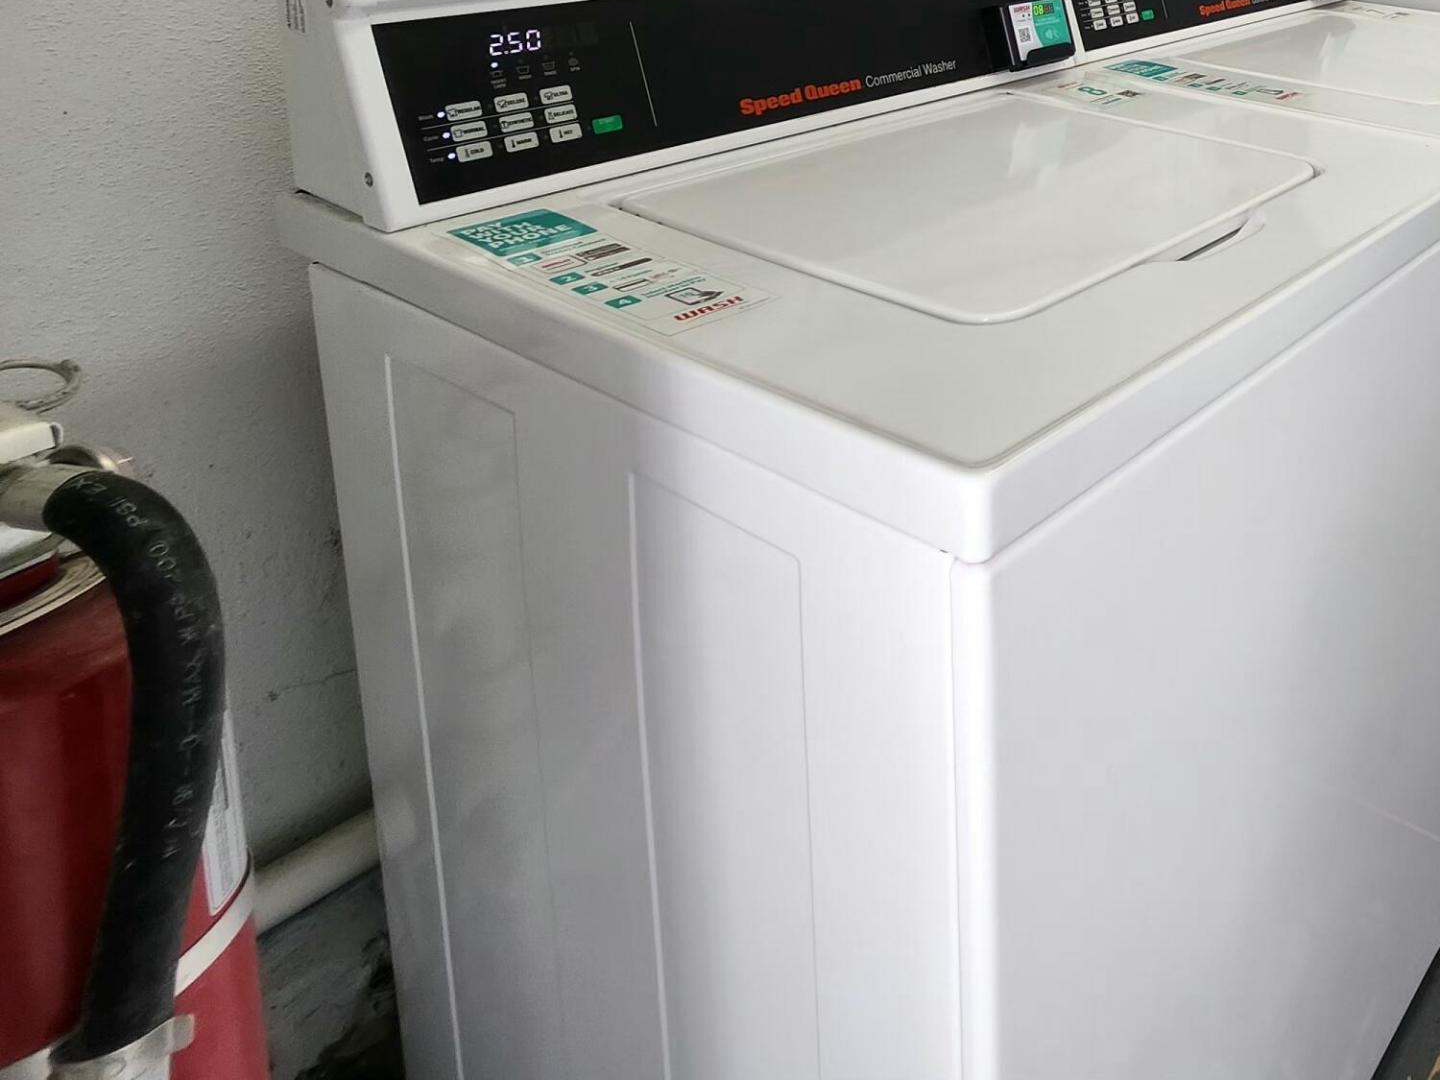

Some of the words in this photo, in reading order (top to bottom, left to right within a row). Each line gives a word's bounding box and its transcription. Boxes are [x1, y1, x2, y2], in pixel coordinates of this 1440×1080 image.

[1199, 1, 1225, 16] Speed
[488, 29, 542, 56] 2.50
[739, 88, 802, 115] Speed
[804, 78, 862, 100] Queen
[865, 65, 922, 88] Commercial
[922, 59, 957, 75] Washer
[460, 221, 502, 235] PAY
[468, 221, 532, 239] WITH
[478, 224, 545, 243] YOUR
[488, 223, 573, 249] PHONE
[672, 295, 744, 322] WASH
